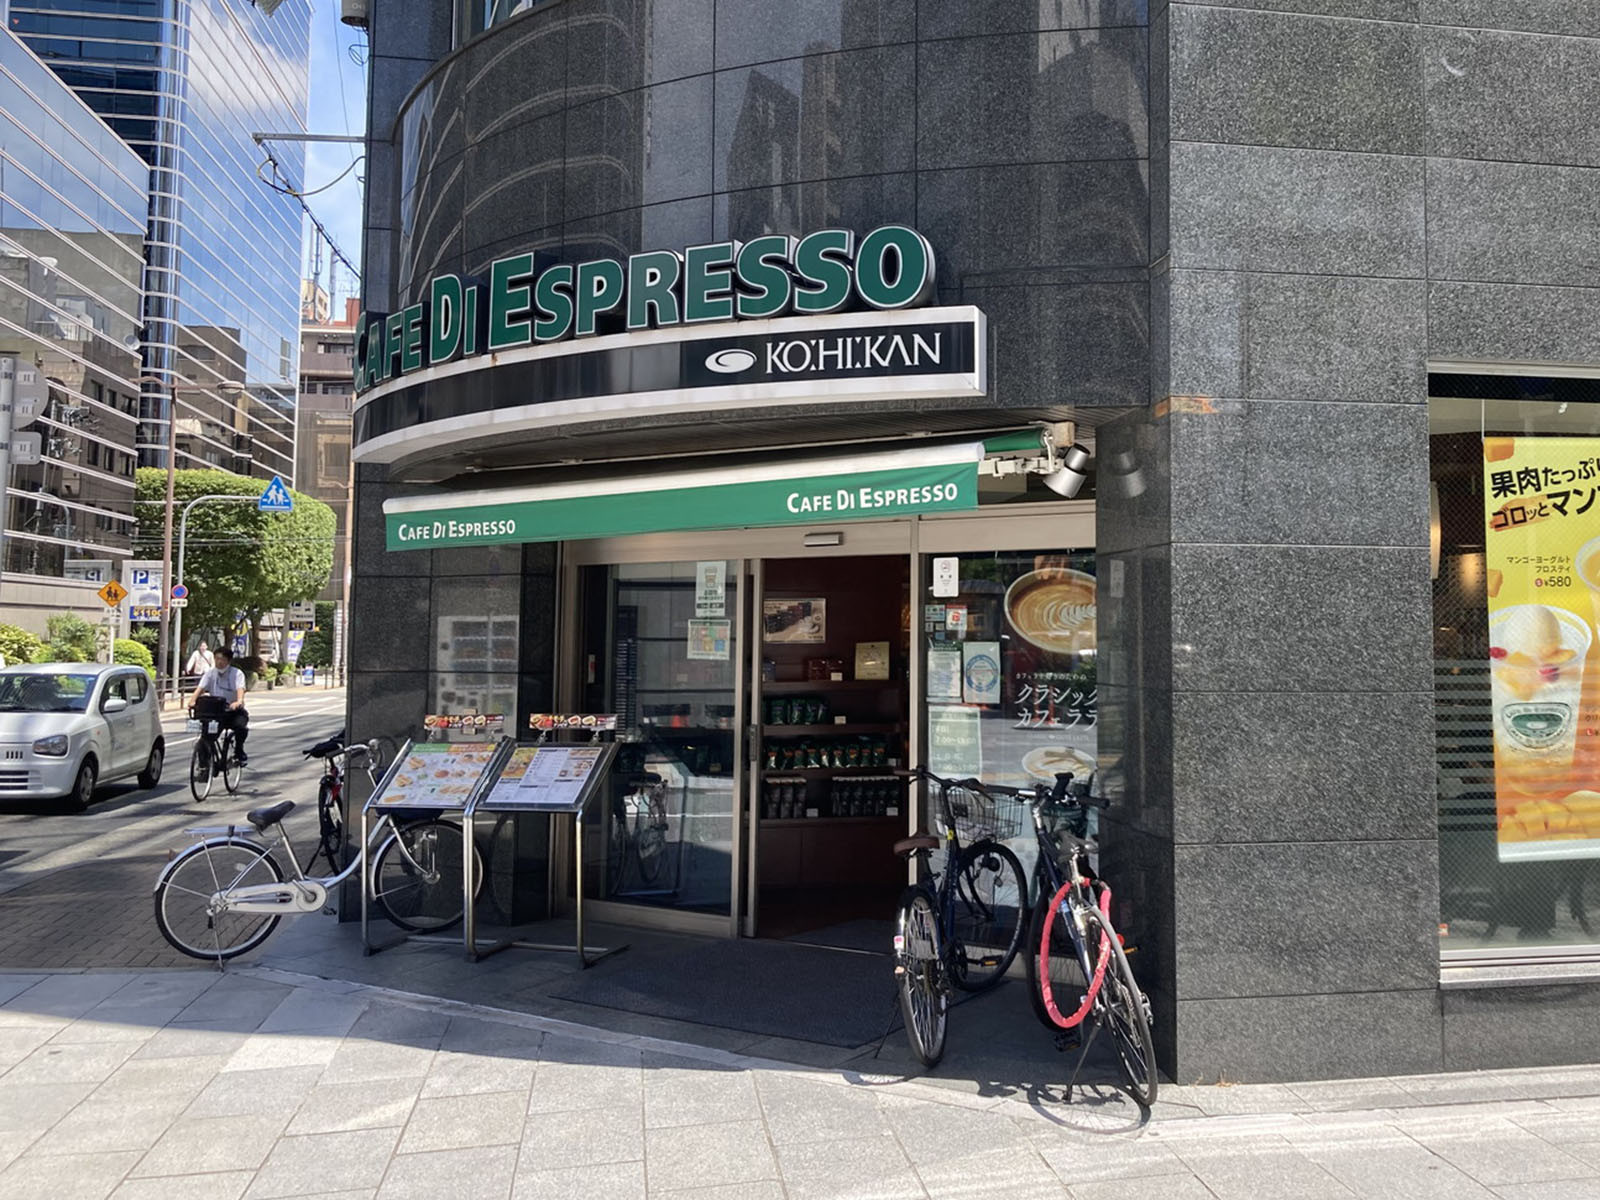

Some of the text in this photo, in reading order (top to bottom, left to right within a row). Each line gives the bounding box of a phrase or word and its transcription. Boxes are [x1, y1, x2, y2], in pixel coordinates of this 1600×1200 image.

[353, 224, 932, 393] CAFE DI ESPRESSO
[786, 492, 833, 514] CAFE
[859, 483, 957, 508] ESPRESSO
[399, 524, 430, 541] CAFE
[448, 519, 516, 537] ESPRESSO
